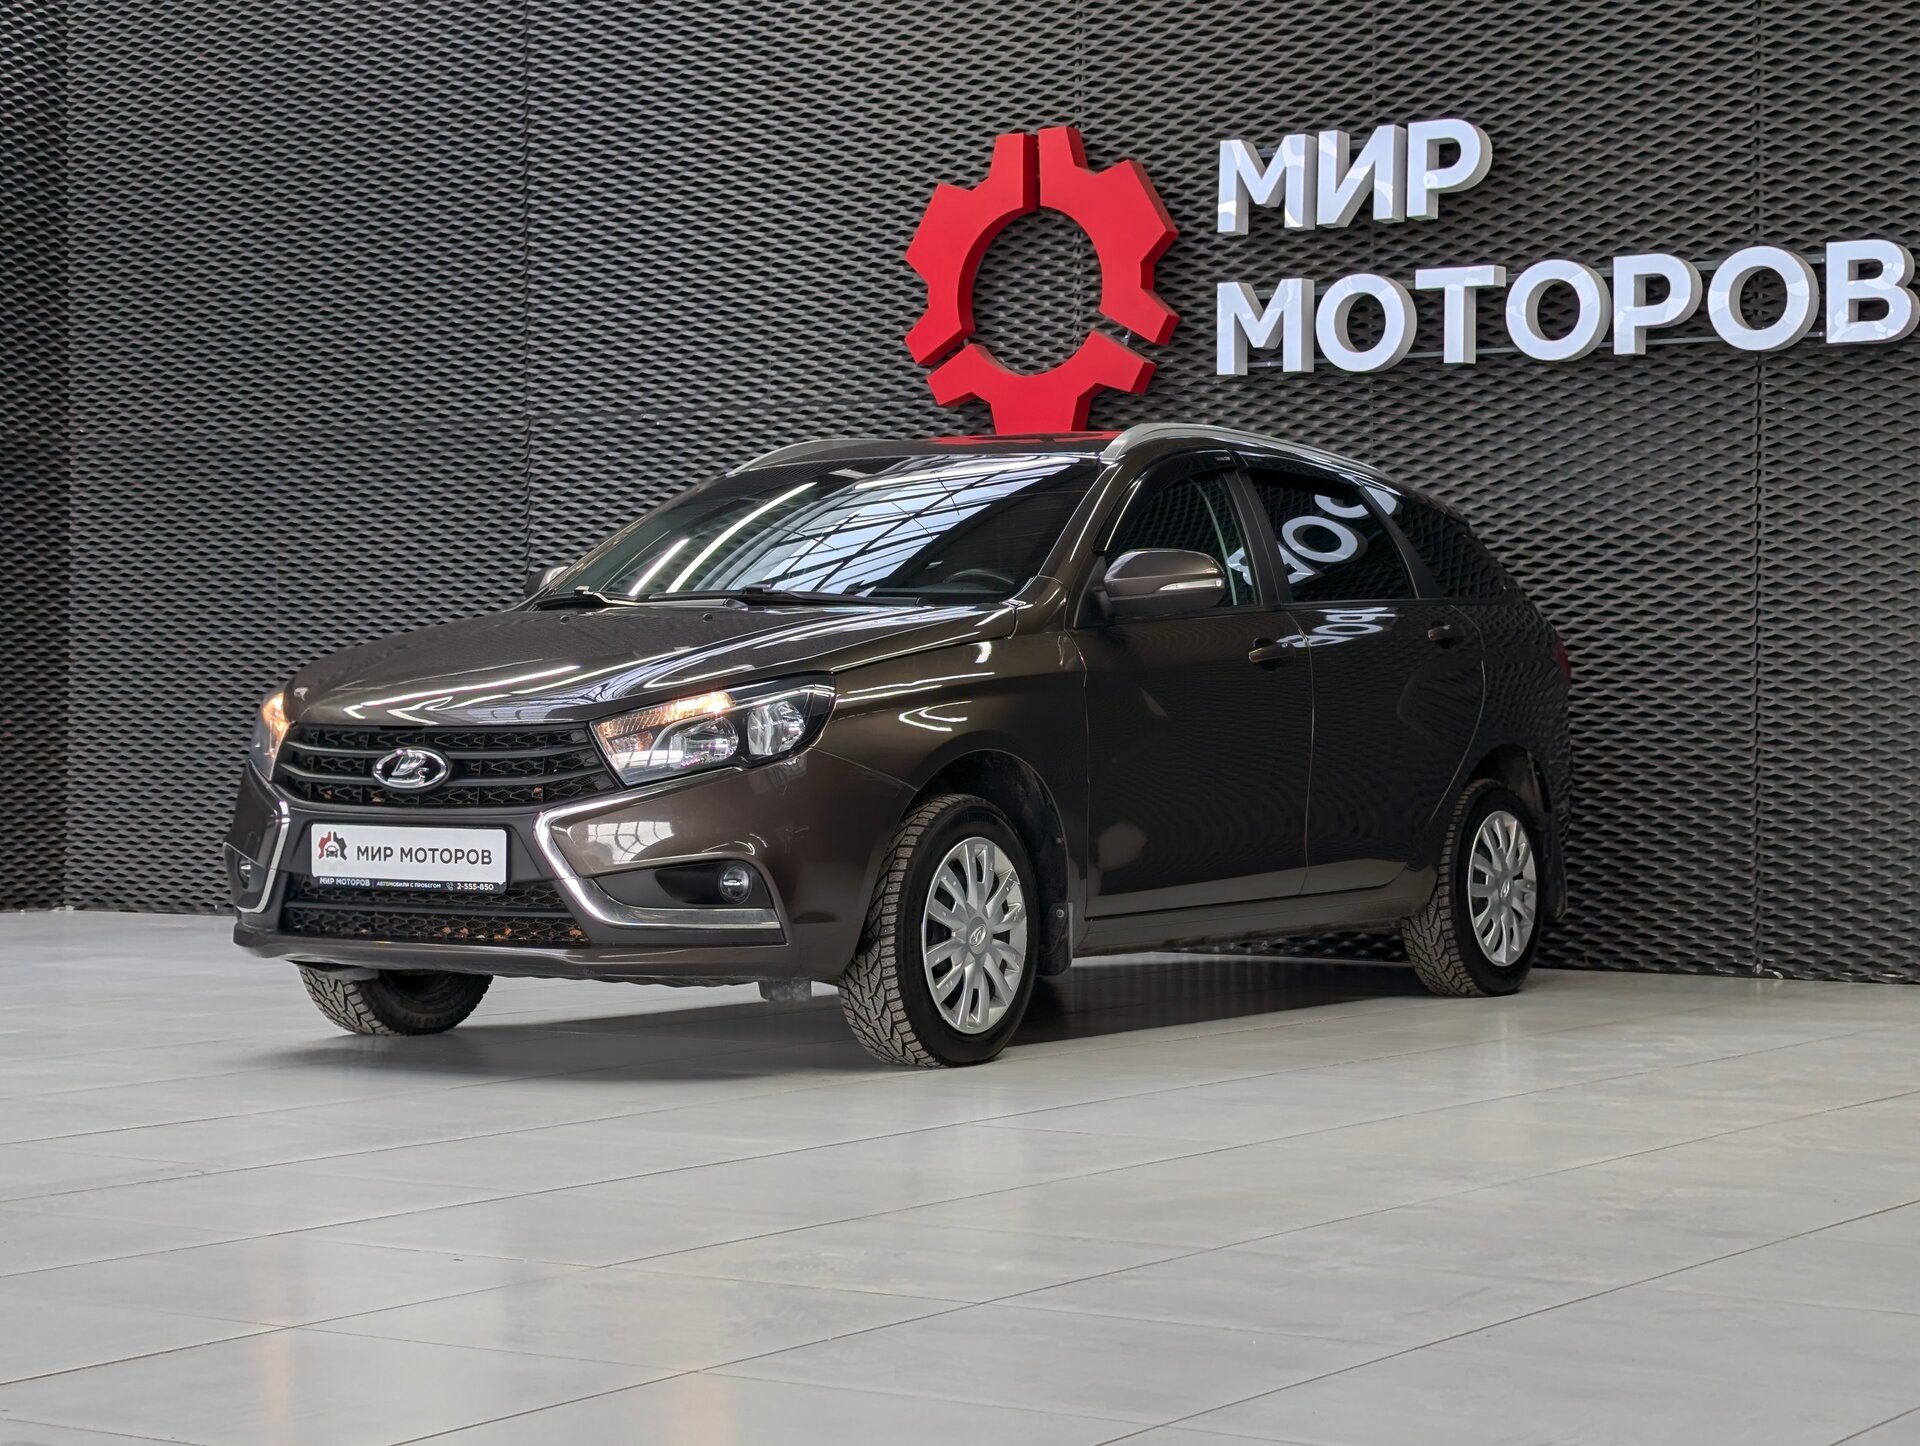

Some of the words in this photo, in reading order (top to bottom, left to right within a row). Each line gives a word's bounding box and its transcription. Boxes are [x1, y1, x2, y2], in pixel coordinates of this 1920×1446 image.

[1217, 118, 1492, 235] МИР
[1216, 239, 1919, 375] МОТОРОВ
[356, 845, 394, 862] МИР
[400, 847, 492, 865] МОТОРОВ
[319, 877, 335, 885] МИР
[336, 878, 370, 887] МОТОРОВ
[456, 882, 494, 891] 2-555-850
